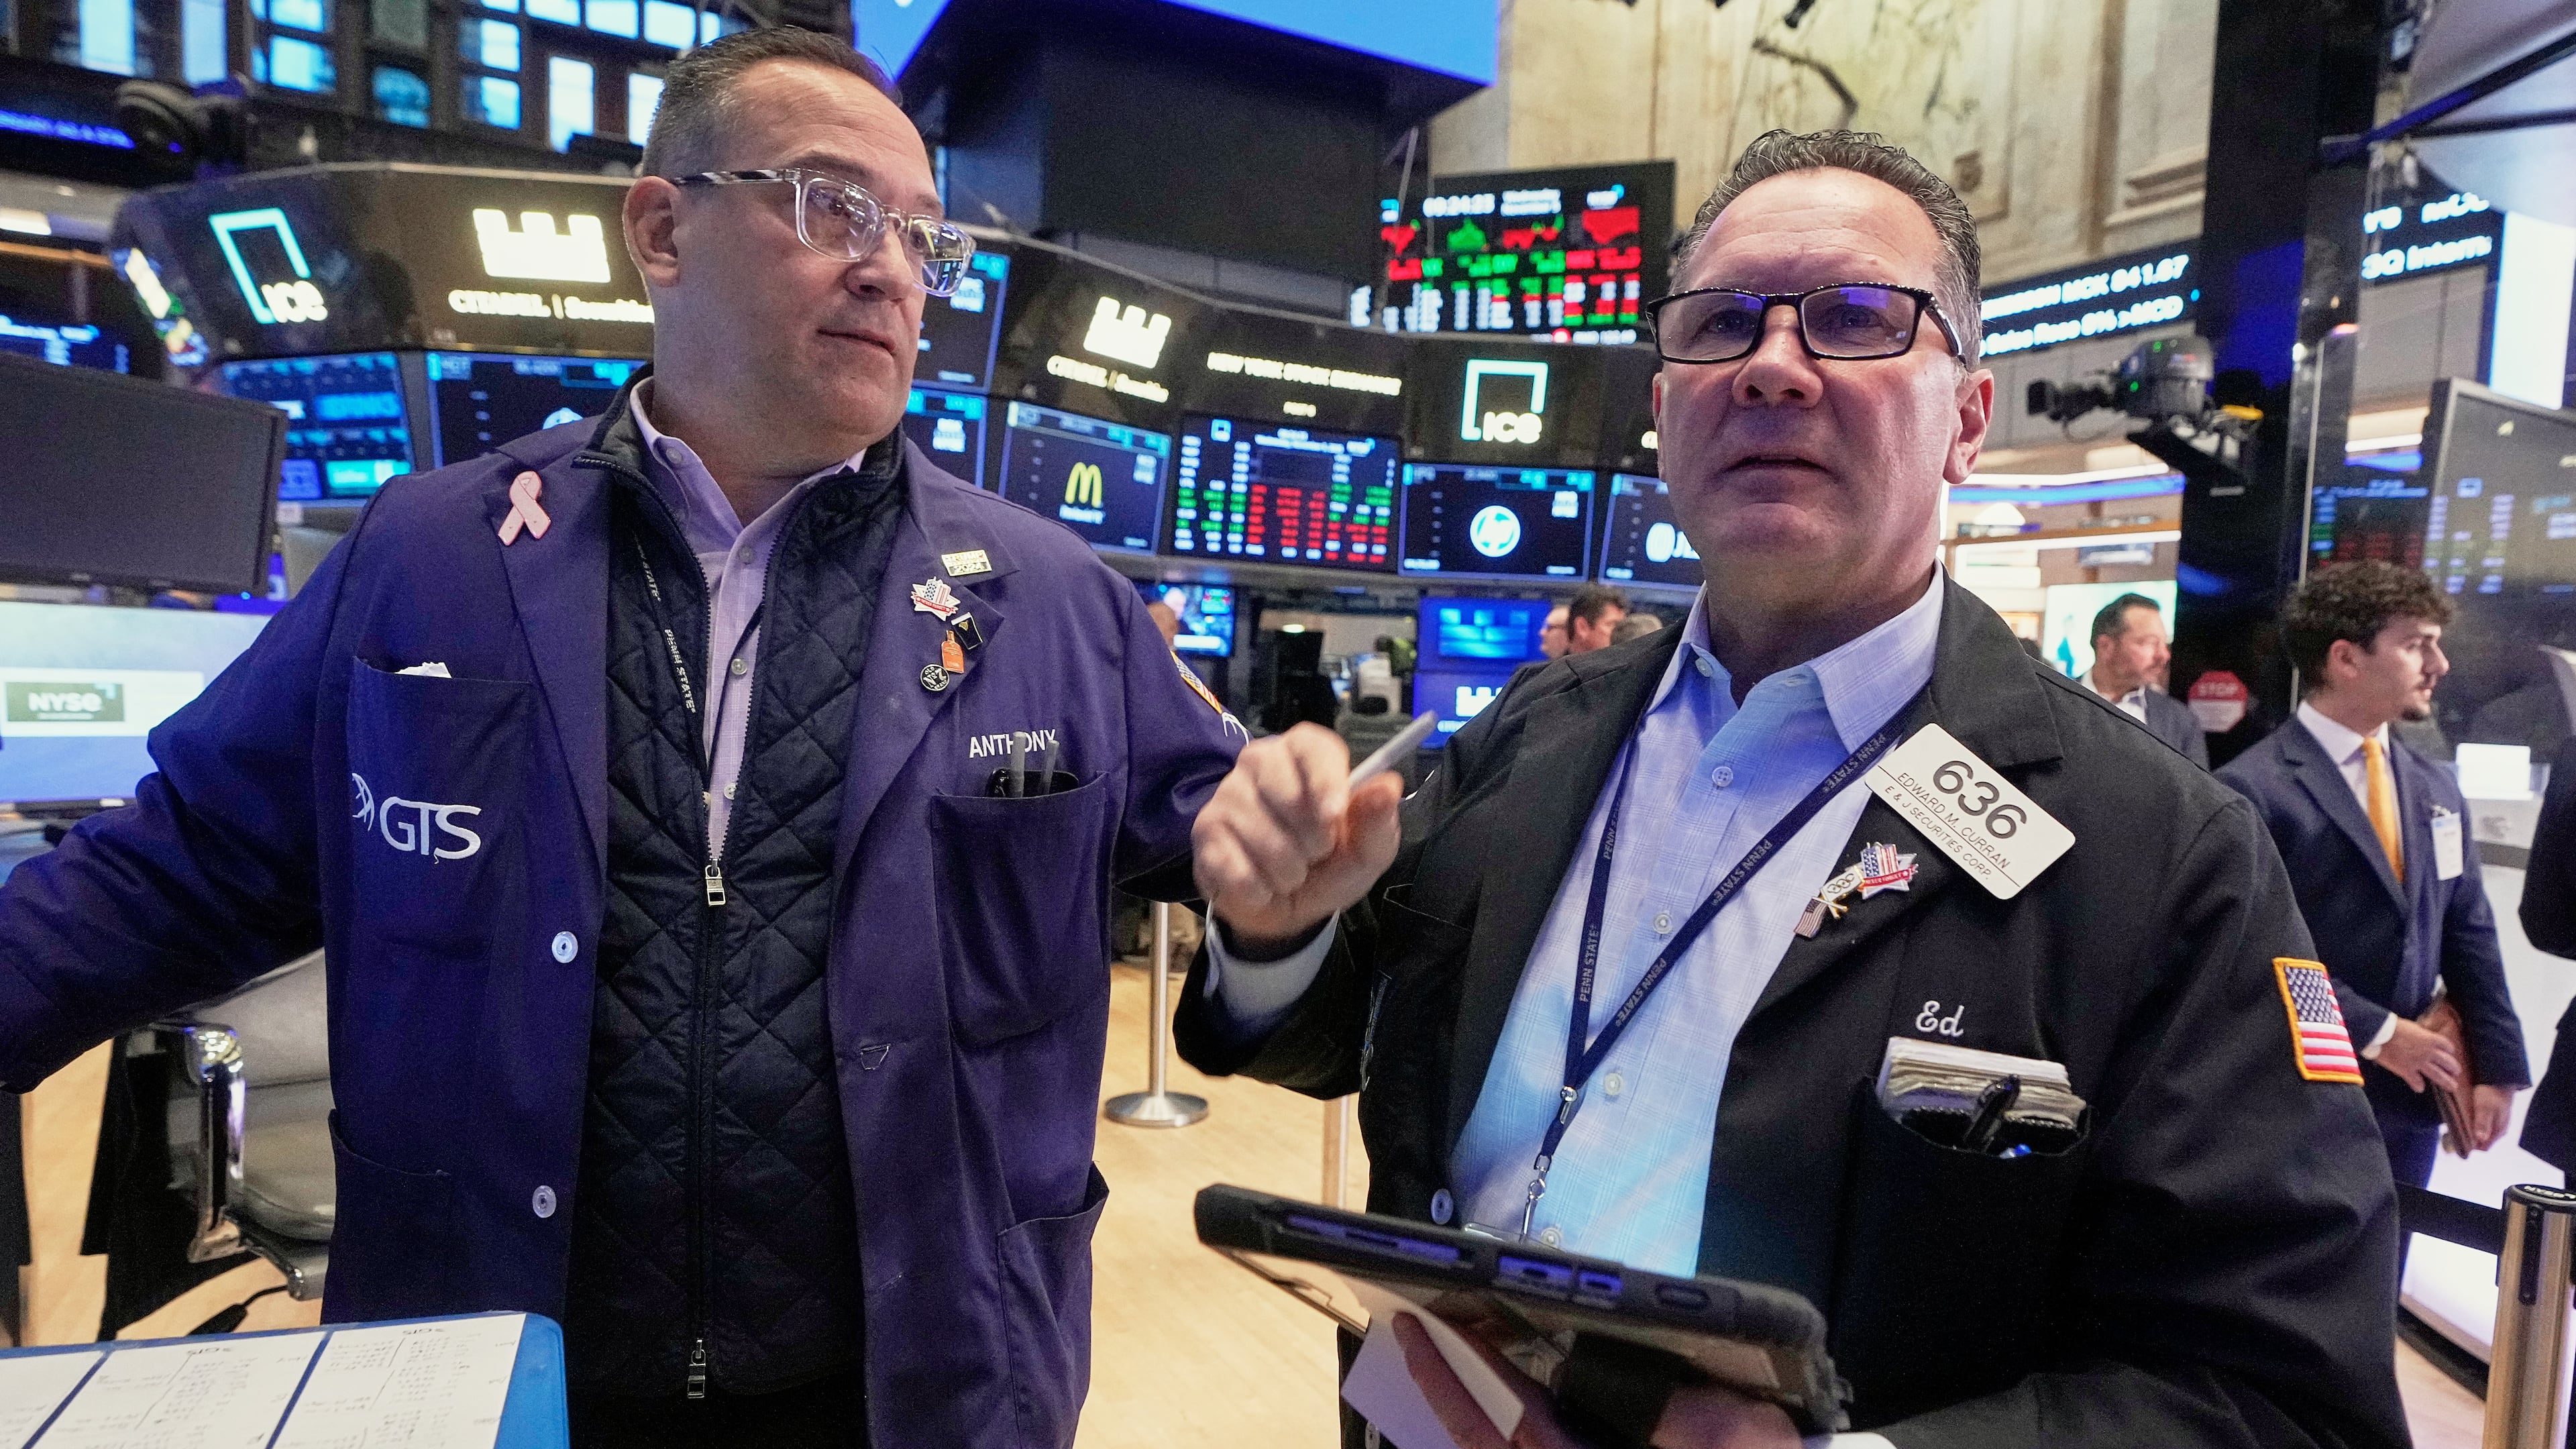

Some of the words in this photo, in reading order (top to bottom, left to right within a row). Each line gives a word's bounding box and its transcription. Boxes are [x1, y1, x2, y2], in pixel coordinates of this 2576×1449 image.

[380, 796, 482, 859] GTS
[1884, 786, 1894, 795] E
[1894, 793, 1903, 803] &
[1902, 799, 1911, 809] J
[1909, 807, 1964, 855] SECURITIES
[1962, 851, 1992, 881] CORP.
[1897, 772, 1946, 815] EDWARD
[1944, 812, 1959, 828] M.
[1961, 827, 2010, 869] CURRAN
[1933, 760, 2027, 839] 636
[1915, 1000, 1965, 1037] Ed
